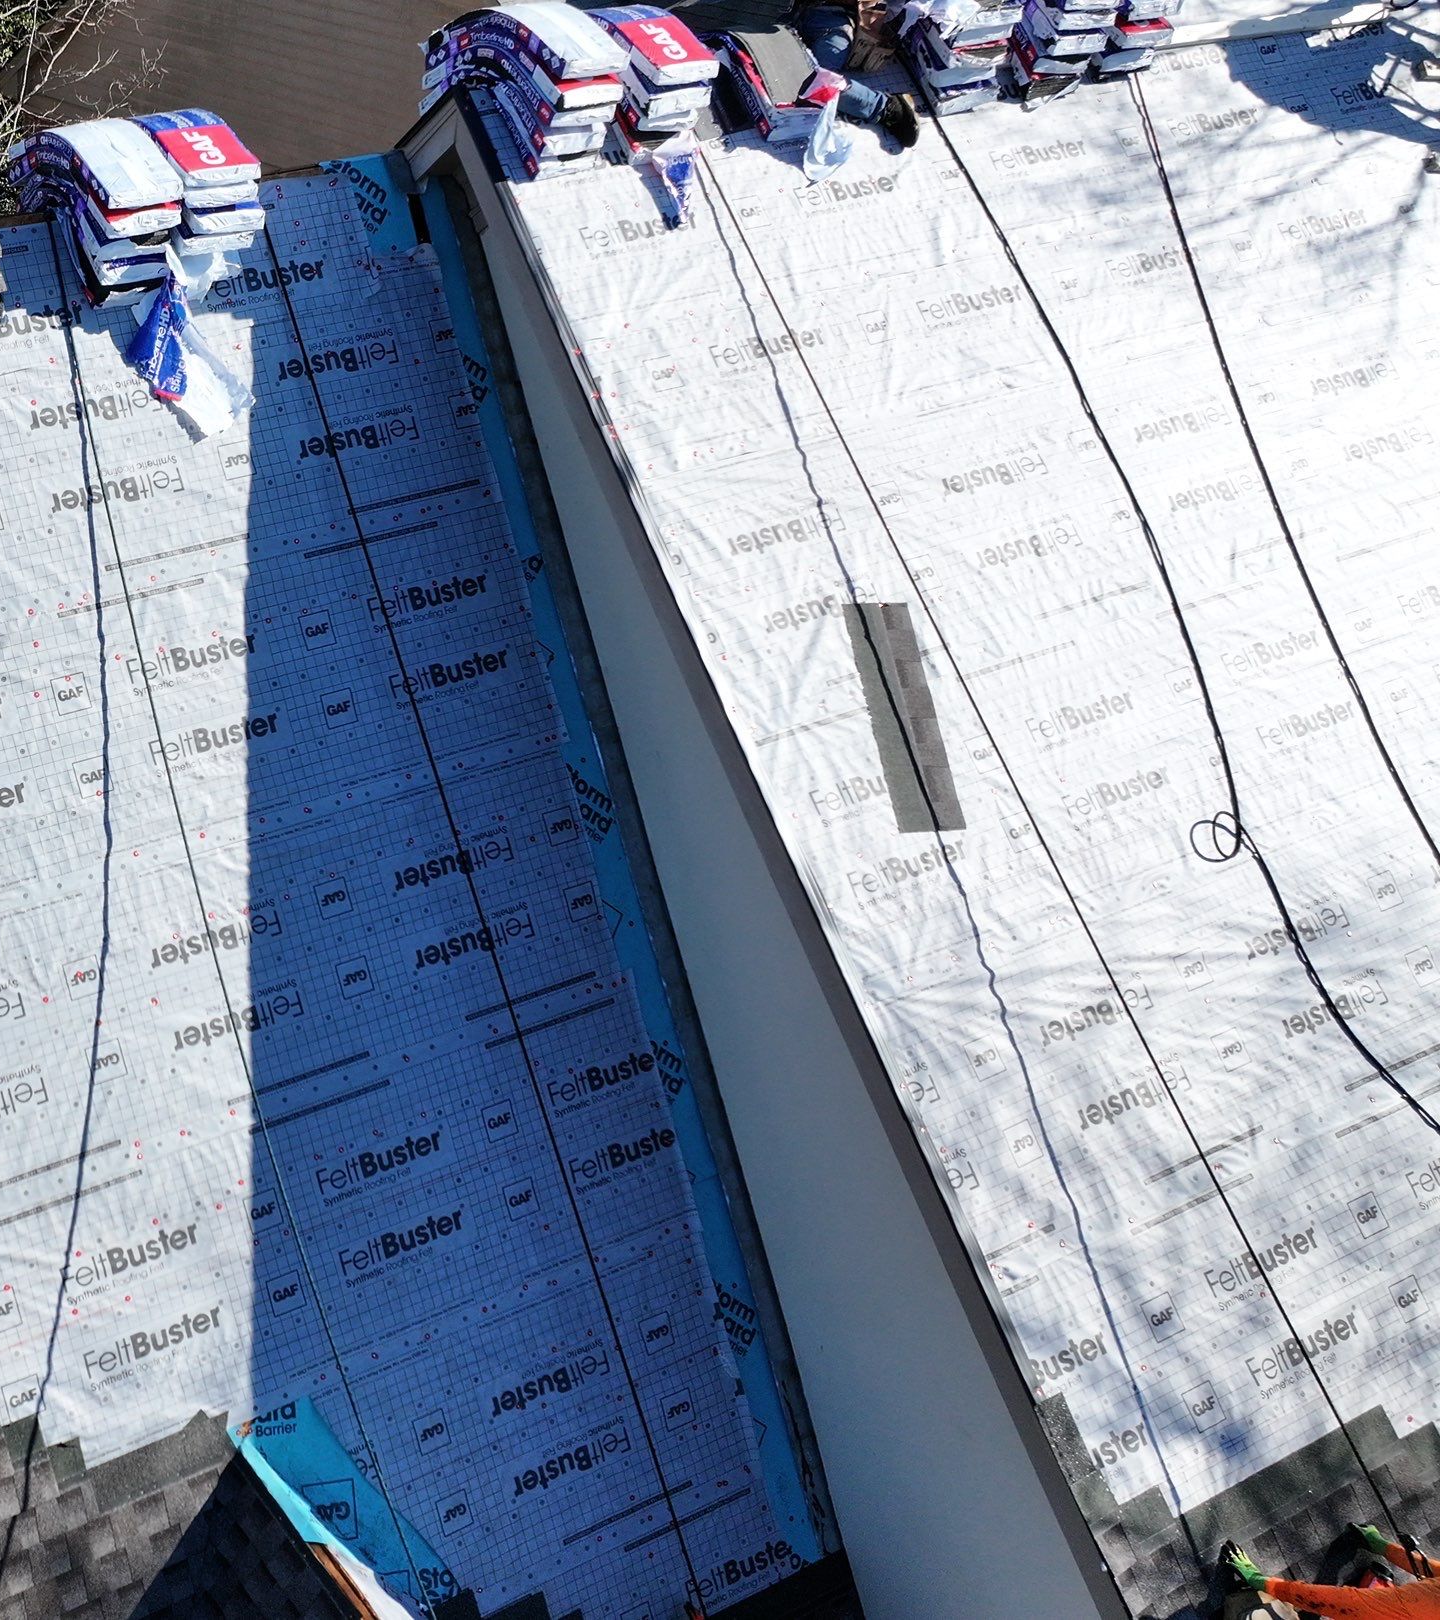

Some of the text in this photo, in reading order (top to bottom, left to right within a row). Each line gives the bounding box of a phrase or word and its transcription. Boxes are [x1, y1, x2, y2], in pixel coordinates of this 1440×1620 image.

[640, 24, 687, 60] GAF
[1166, 106, 1258, 138] FeltBuster
[183, 131, 227, 166] GAF
[990, 137, 1086, 172] FeltBuster
[794, 172, 900, 210] FeltBuster
[1105, 246, 1200, 280] FeltBuster
[206, 298, 247, 313] Synthetic
[915, 281, 1024, 322] FeltBuster
[278, 341, 399, 381] FeltBuster
[708, 324, 825, 371] FeltBuster
[369, 405, 414, 421] Synthetic
[299, 418, 419, 459] FeltBuster
[134, 455, 178, 473] Synthetic
[225, 453, 251, 469] GAF
[943, 455, 1049, 496] FeltBuster
[52, 468, 184, 512] FeltBuster
[730, 509, 847, 556] FeltBuster
[366, 574, 486, 621] FeltBuster
[304, 623, 330, 639] GAF
[126, 633, 255, 685] FeltBuster
[1220, 628, 1320, 676] FeltBuster
[388, 649, 507, 696] FeltBuster
[57, 684, 84, 702] GAF
[326, 701, 352, 717] GAF
[1026, 690, 1135, 744] FeltBuster
[1255, 700, 1355, 749] FeltBuster
[148, 713, 277, 766] FeltBuster
[79, 768, 107, 785] GAF
[1062, 765, 1170, 820] FeltBuster
[550, 817, 575, 836] GAF
[395, 837, 514, 891] FeltBuster
[846, 838, 965, 896] FeltBuster
[320, 889, 347, 908] GAF
[492, 901, 530, 918] Synthetic
[570, 892, 594, 911] GAF
[151, 910, 283, 969] FeltBuster
[415, 914, 534, 969] FeltBuster
[343, 969, 368, 987] GAF
[1181, 960, 1205, 979] GAF
[175, 990, 304, 1051] FeltBuster
[1040, 983, 1153, 1048] FeltBuster
[93, 1053, 120, 1071] GAF
[972, 1048, 997, 1069] GAF
[1220, 1040, 1244, 1061] GAF
[1080, 1063, 1191, 1130] FeltBuster
[487, 1110, 512, 1130] GAF
[1010, 1132, 1035, 1155] GAF
[316, 1130, 440, 1194] FeltBuster
[323, 1176, 395, 1208] Synthetic Roofing
[509, 1189, 533, 1208] GAF
[576, 1175, 612, 1196] Synthetic
[250, 1201, 277, 1221] GAF
[1356, 1205, 1378, 1223] GAF
[61, 1223, 197, 1290] FeltBuster
[338, 1210, 462, 1274] FeltBuster
[345, 1248, 434, 1289] Synthetic Roofing Felt
[1203, 1227, 1318, 1298] FeltBuster
[67, 1283, 112, 1306] Synthetic
[272, 1284, 299, 1303] GAF
[1397, 1289, 1420, 1309] GAF
[1150, 1307, 1175, 1328] GAF
[83, 1306, 221, 1379] FeltBuster
[646, 1324, 670, 1342] GAF
[568, 1338, 604, 1360] Synthetic
[1245, 1310, 1360, 1387] FeltBuster
[91, 1370, 135, 1393] Synthetic
[492, 1350, 610, 1418] FeltBuster
[1260, 1376, 1297, 1402] Synthetic
[9, 1387, 39, 1408] GAF
[667, 1400, 691, 1419] GAF
[1191, 1397, 1217, 1417] GAF
[255, 1422, 297, 1438] Barrier
[420, 1423, 444, 1443] GAF
[589, 1415, 625, 1438] Synthetic
[514, 1427, 631, 1498] FeltBuster
[443, 1503, 467, 1524] GAF
